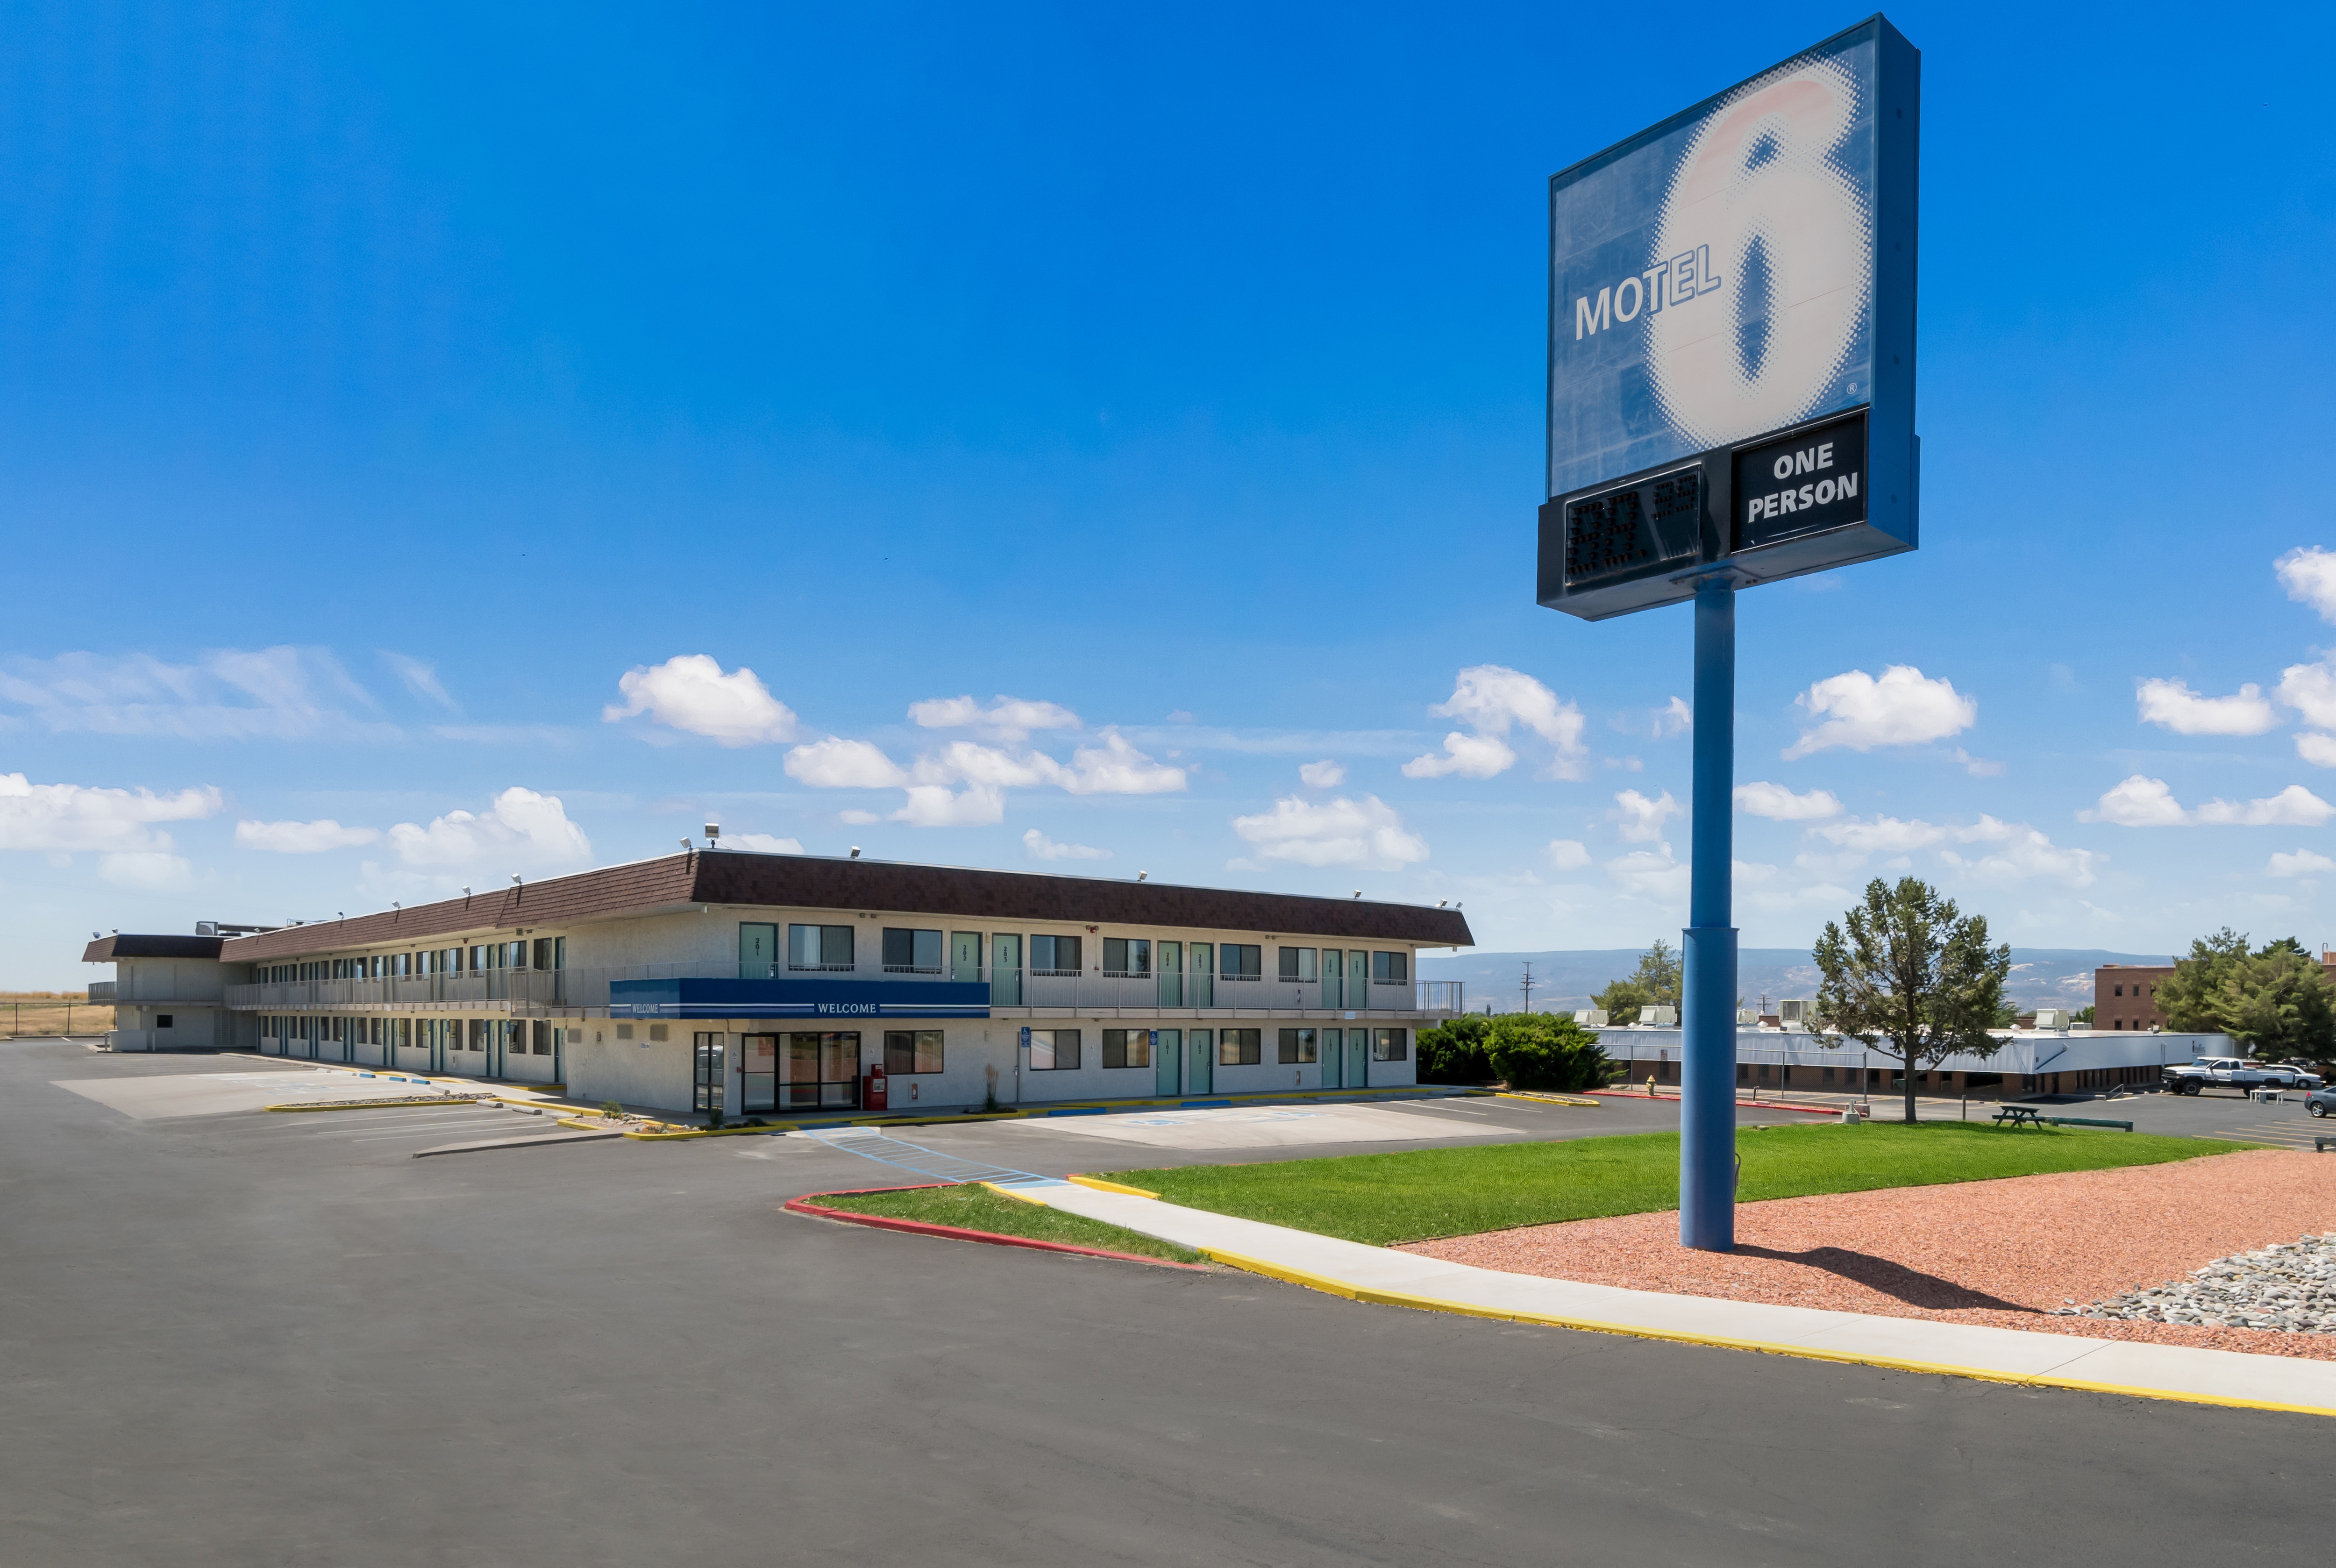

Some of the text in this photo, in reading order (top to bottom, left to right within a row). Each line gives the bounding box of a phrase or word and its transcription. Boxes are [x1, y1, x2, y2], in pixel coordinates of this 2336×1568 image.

[1576, 50, 1871, 449] MOTEL 6
[1773, 442, 1833, 479] ONE
[1748, 472, 1858, 523] PERSON
[632, 1004, 658, 1013] WELCOME
[818, 1003, 876, 1013] WELCOME
